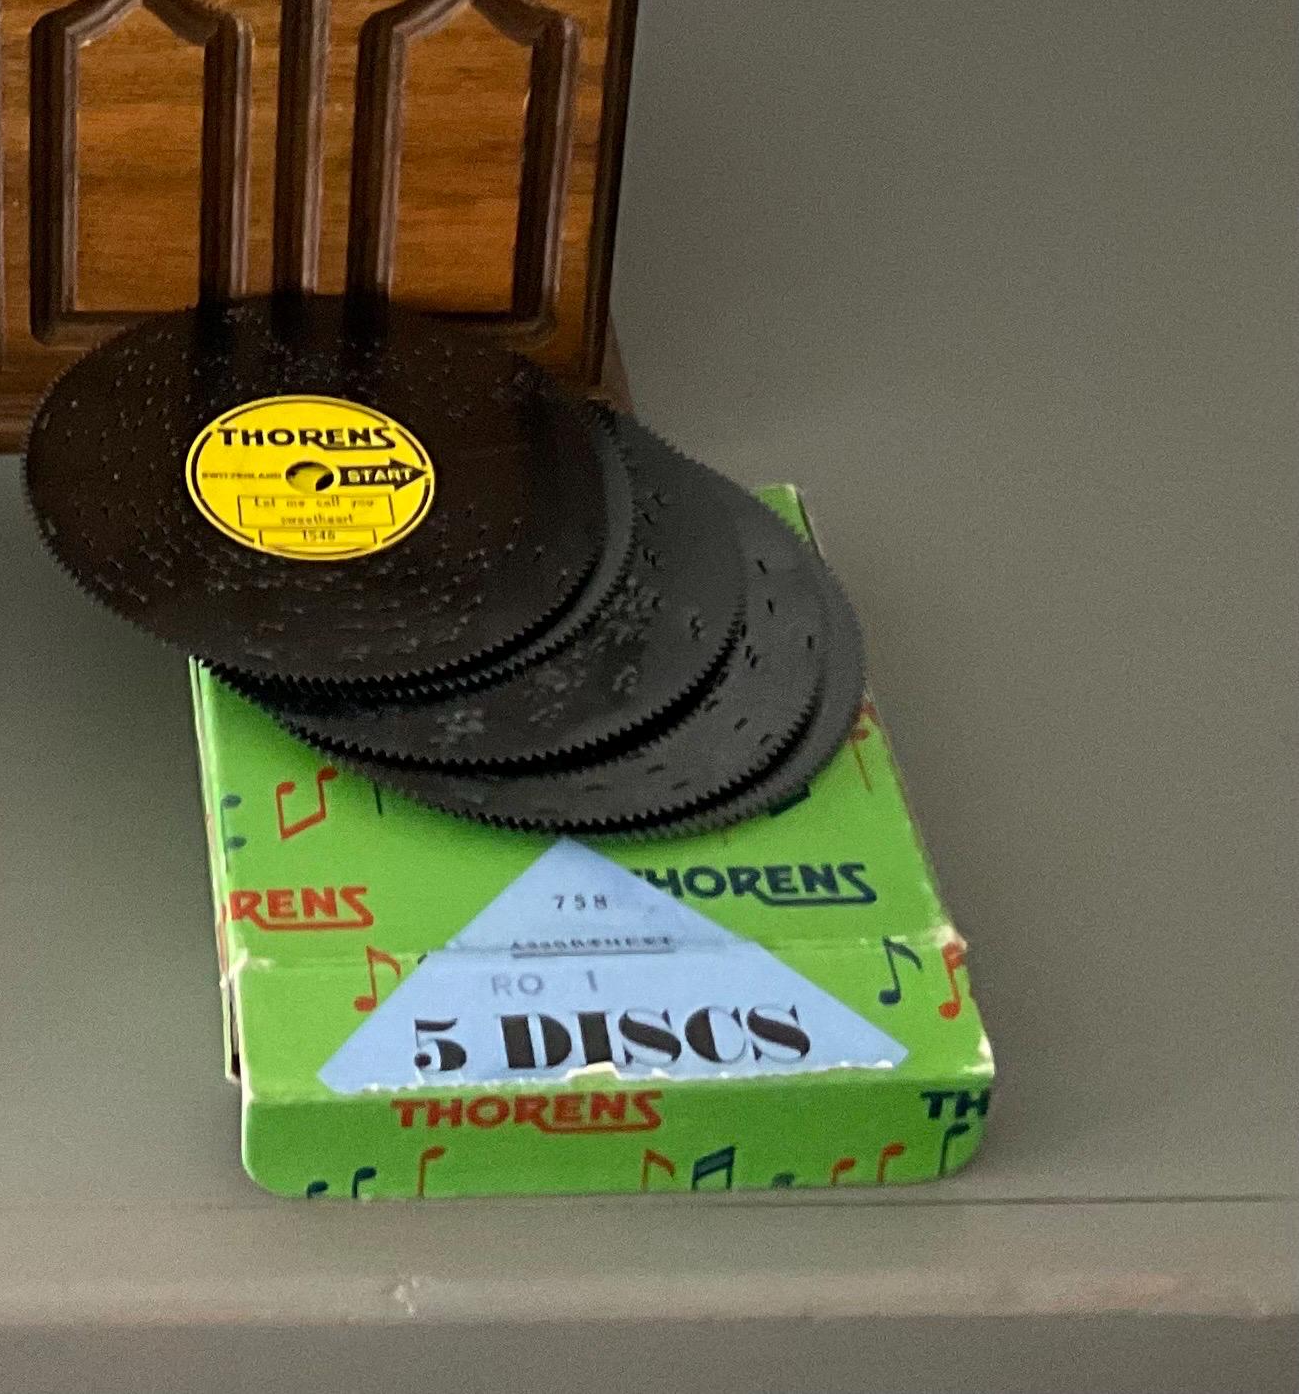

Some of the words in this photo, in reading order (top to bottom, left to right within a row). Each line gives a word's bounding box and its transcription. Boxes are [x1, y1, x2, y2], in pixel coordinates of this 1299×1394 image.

[217, 428, 396, 451] THORENS
[347, 465, 413, 483] START
[280, 513, 353, 525] sweetheart
[351, 499, 374, 509] you
[631, 862, 877, 905] HORENS
[229, 886, 374, 931] RENS
[413, 1016, 467, 1072] 5
[500, 1005, 812, 1069] DISCS
[391, 1090, 662, 1134] THORENS
